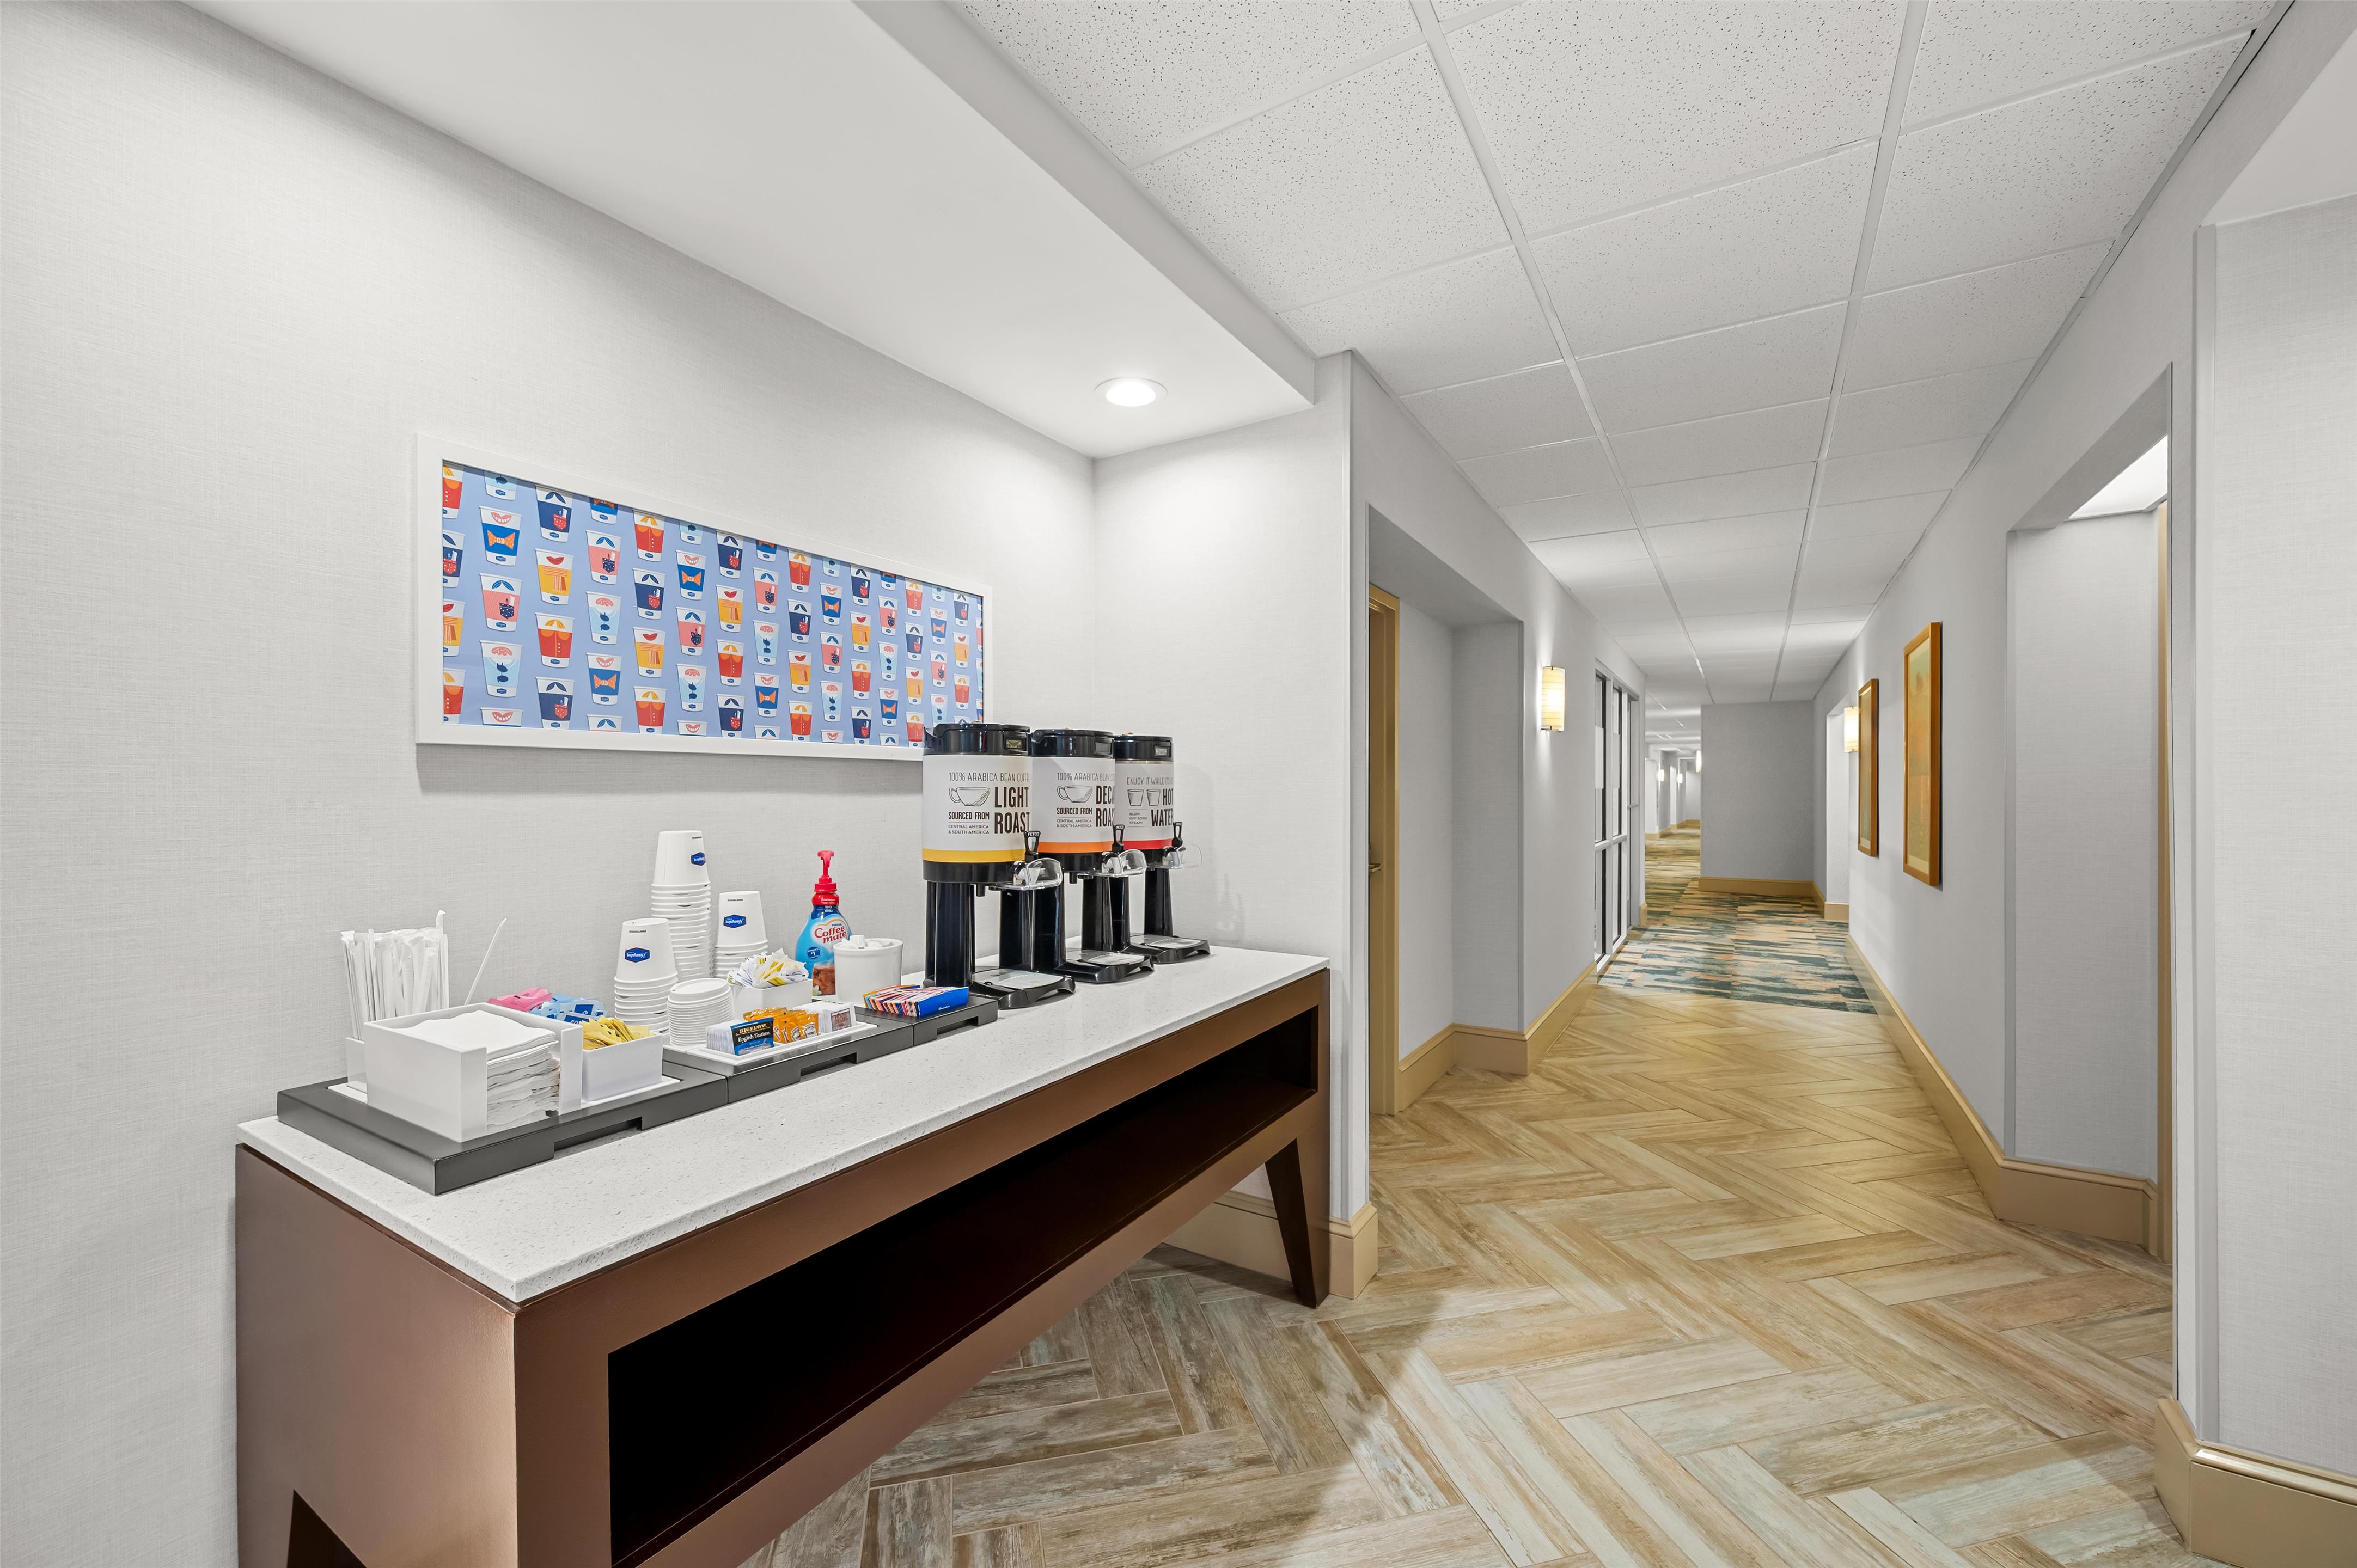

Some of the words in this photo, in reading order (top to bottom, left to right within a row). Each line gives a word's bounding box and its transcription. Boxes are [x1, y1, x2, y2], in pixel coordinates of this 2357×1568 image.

[949, 772, 966, 782] 100%
[967, 772, 998, 782] ARABICA
[1000, 773, 1016, 782] BEAN
[1017, 773, 1030, 782] COFFEE
[1057, 772, 1072, 781] 100%
[1074, 773, 1098, 781] ARABICA
[1100, 773, 1110, 781] BEAN
[1127, 777, 1144, 785] ENJOY
[994, 786, 1029, 808] LIGHT
[1096, 785, 1115, 805] DECA
[1163, 788, 1173, 806] HOT
[948, 812, 973, 820] SOURCED
[974, 812, 990, 820] FROM
[1096, 808, 1115, 827] ROAS
[1151, 808, 1173, 826] WATER
[994, 812, 1030, 834] ROAST
[814, 926, 845, 938] Coffee
[739, 1024, 767, 1033] BIGELOW
[738, 1034, 754, 1043] English
